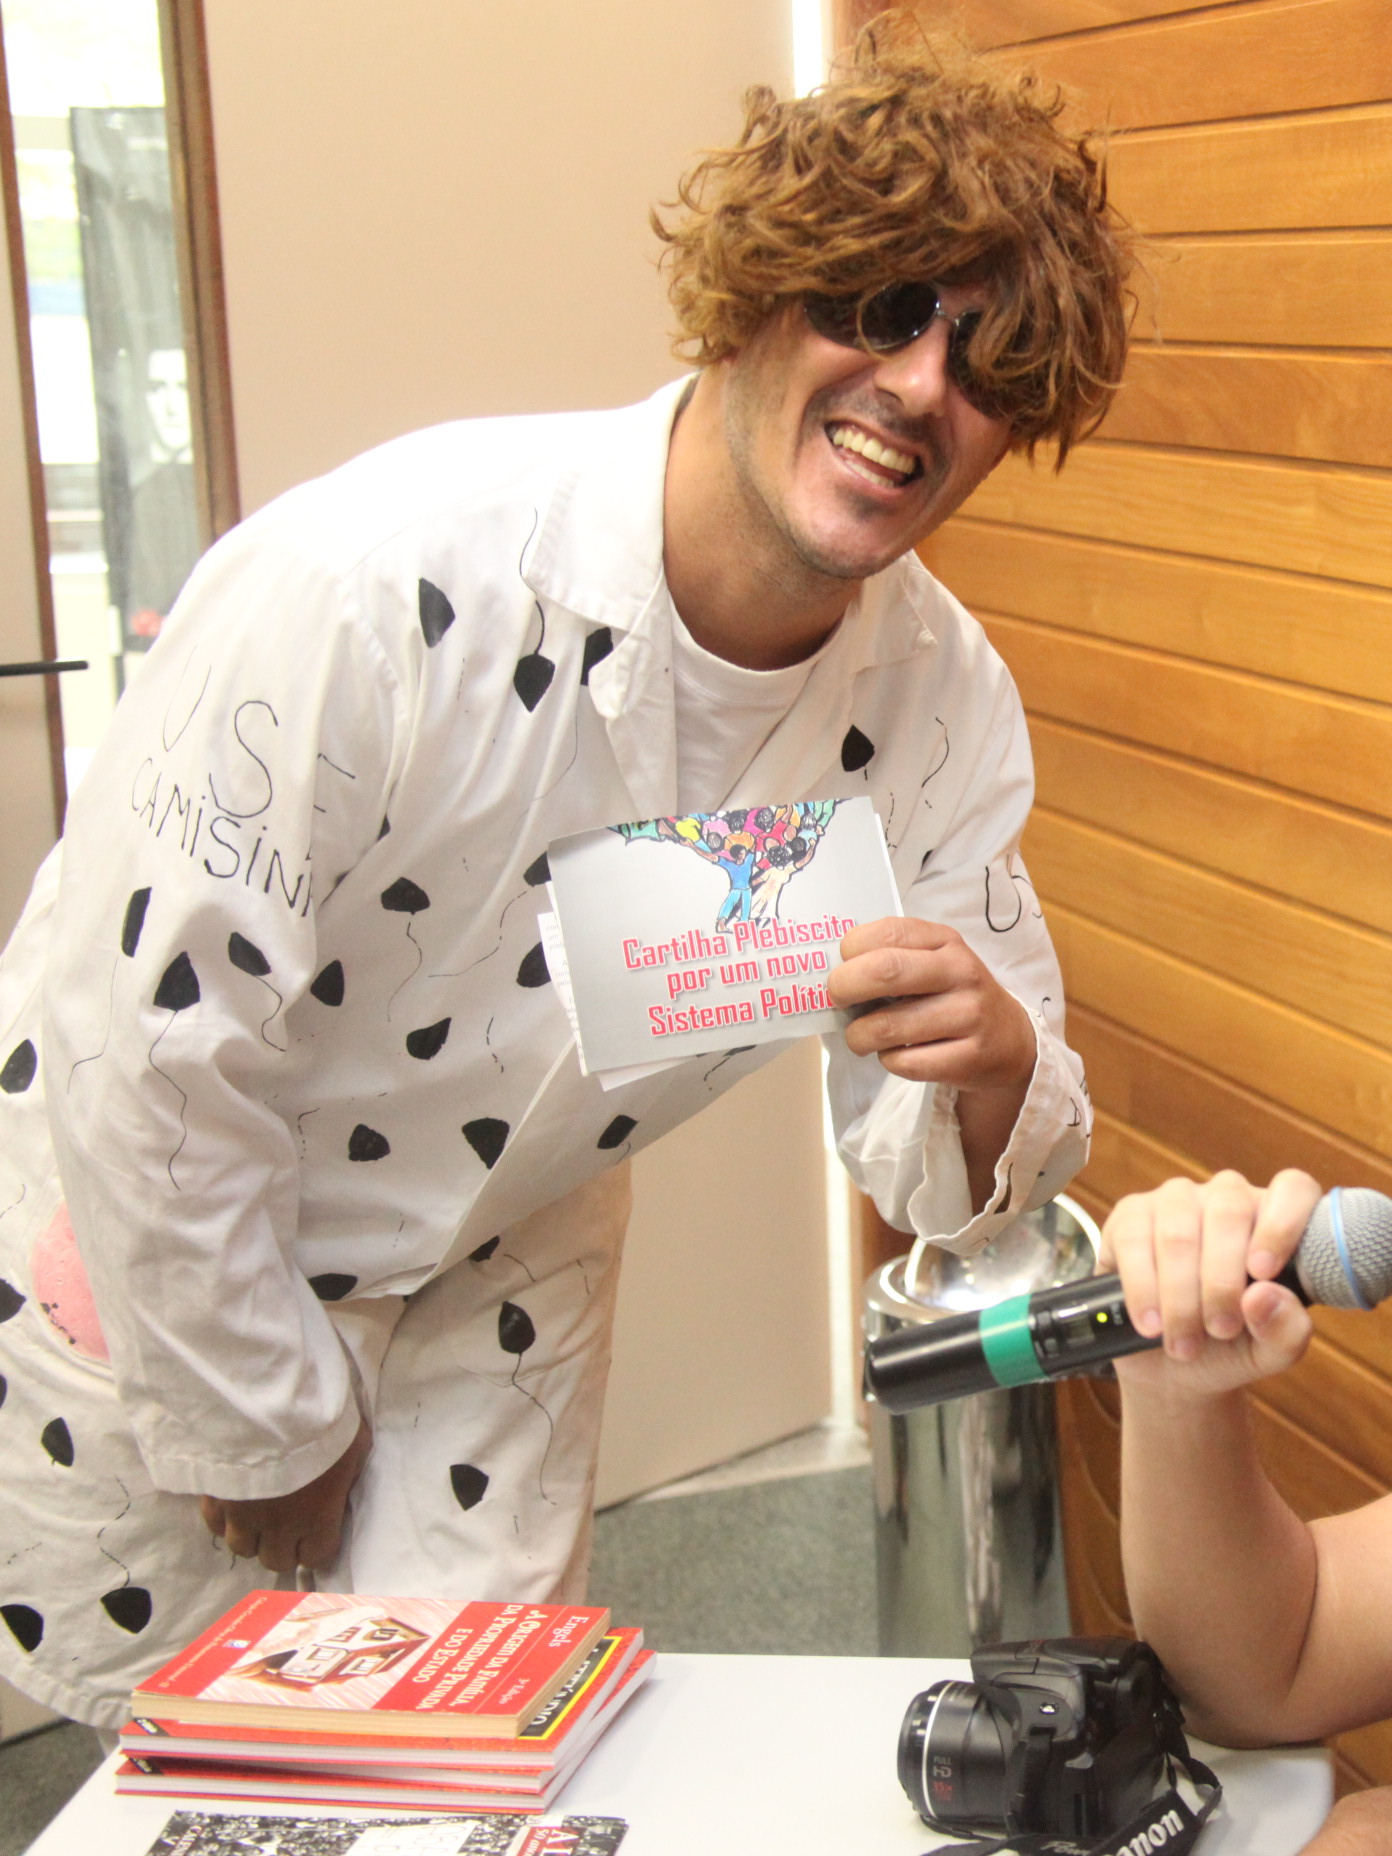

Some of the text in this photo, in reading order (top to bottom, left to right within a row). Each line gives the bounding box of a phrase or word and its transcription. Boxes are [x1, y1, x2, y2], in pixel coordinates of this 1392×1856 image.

[621, 928, 729, 970] Cartilha
[666, 949, 828, 1001] por um novo
[648, 1000, 755, 1037] Sistema
[525, 1609, 548, 1620] A
[548, 1615, 590, 1648] Engels
